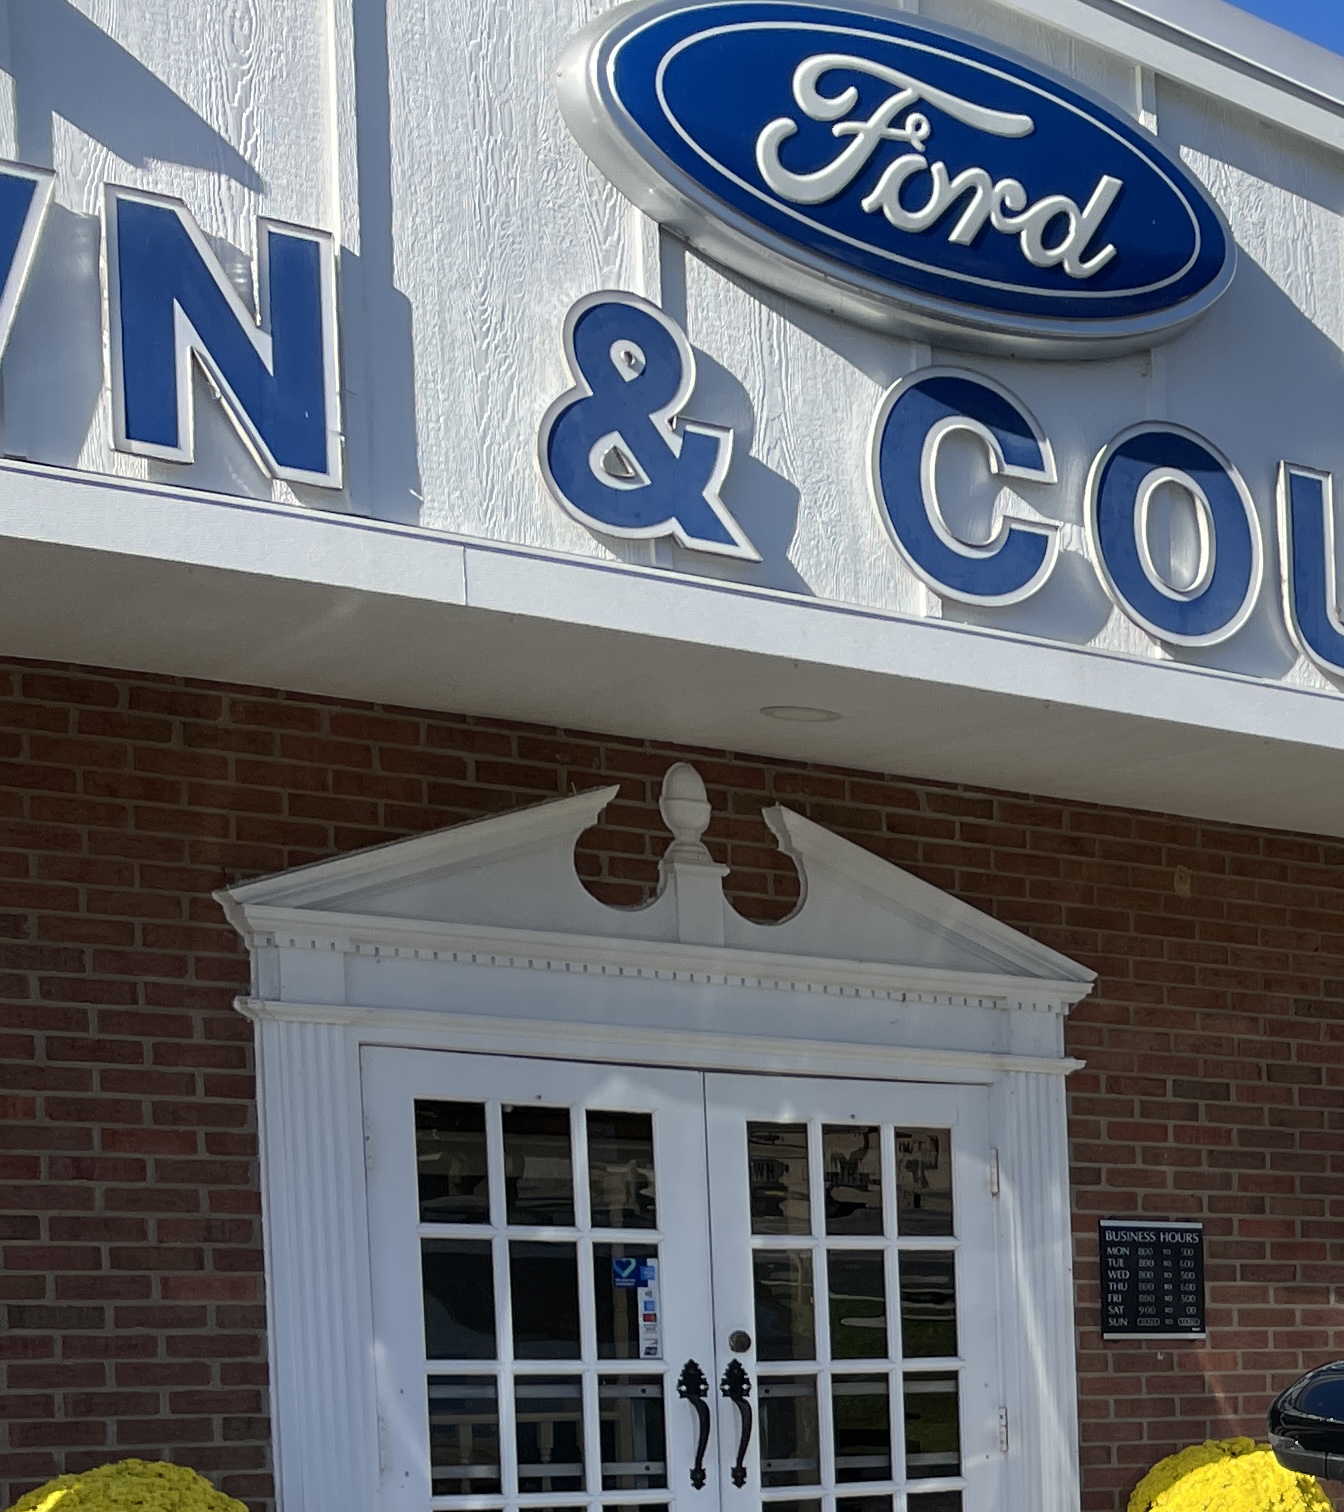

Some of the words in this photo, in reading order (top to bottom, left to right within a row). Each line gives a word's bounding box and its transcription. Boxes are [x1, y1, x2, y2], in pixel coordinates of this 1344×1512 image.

[755, 53, 1124, 279] Ford
[537, 289, 763, 562] &
[1105, 1230, 1157, 1242] BUSINESS
[1160, 1231, 1200, 1244] HOURS
[1107, 1246, 1130, 1256] MON
[1108, 1270, 1130, 1279] WED
[1108, 1282, 1128, 1291] THU
[1108, 1294, 1122, 1303] FRI
[1108, 1306, 1125, 1315] SAT
[1108, 1318, 1128, 1326] SUN
